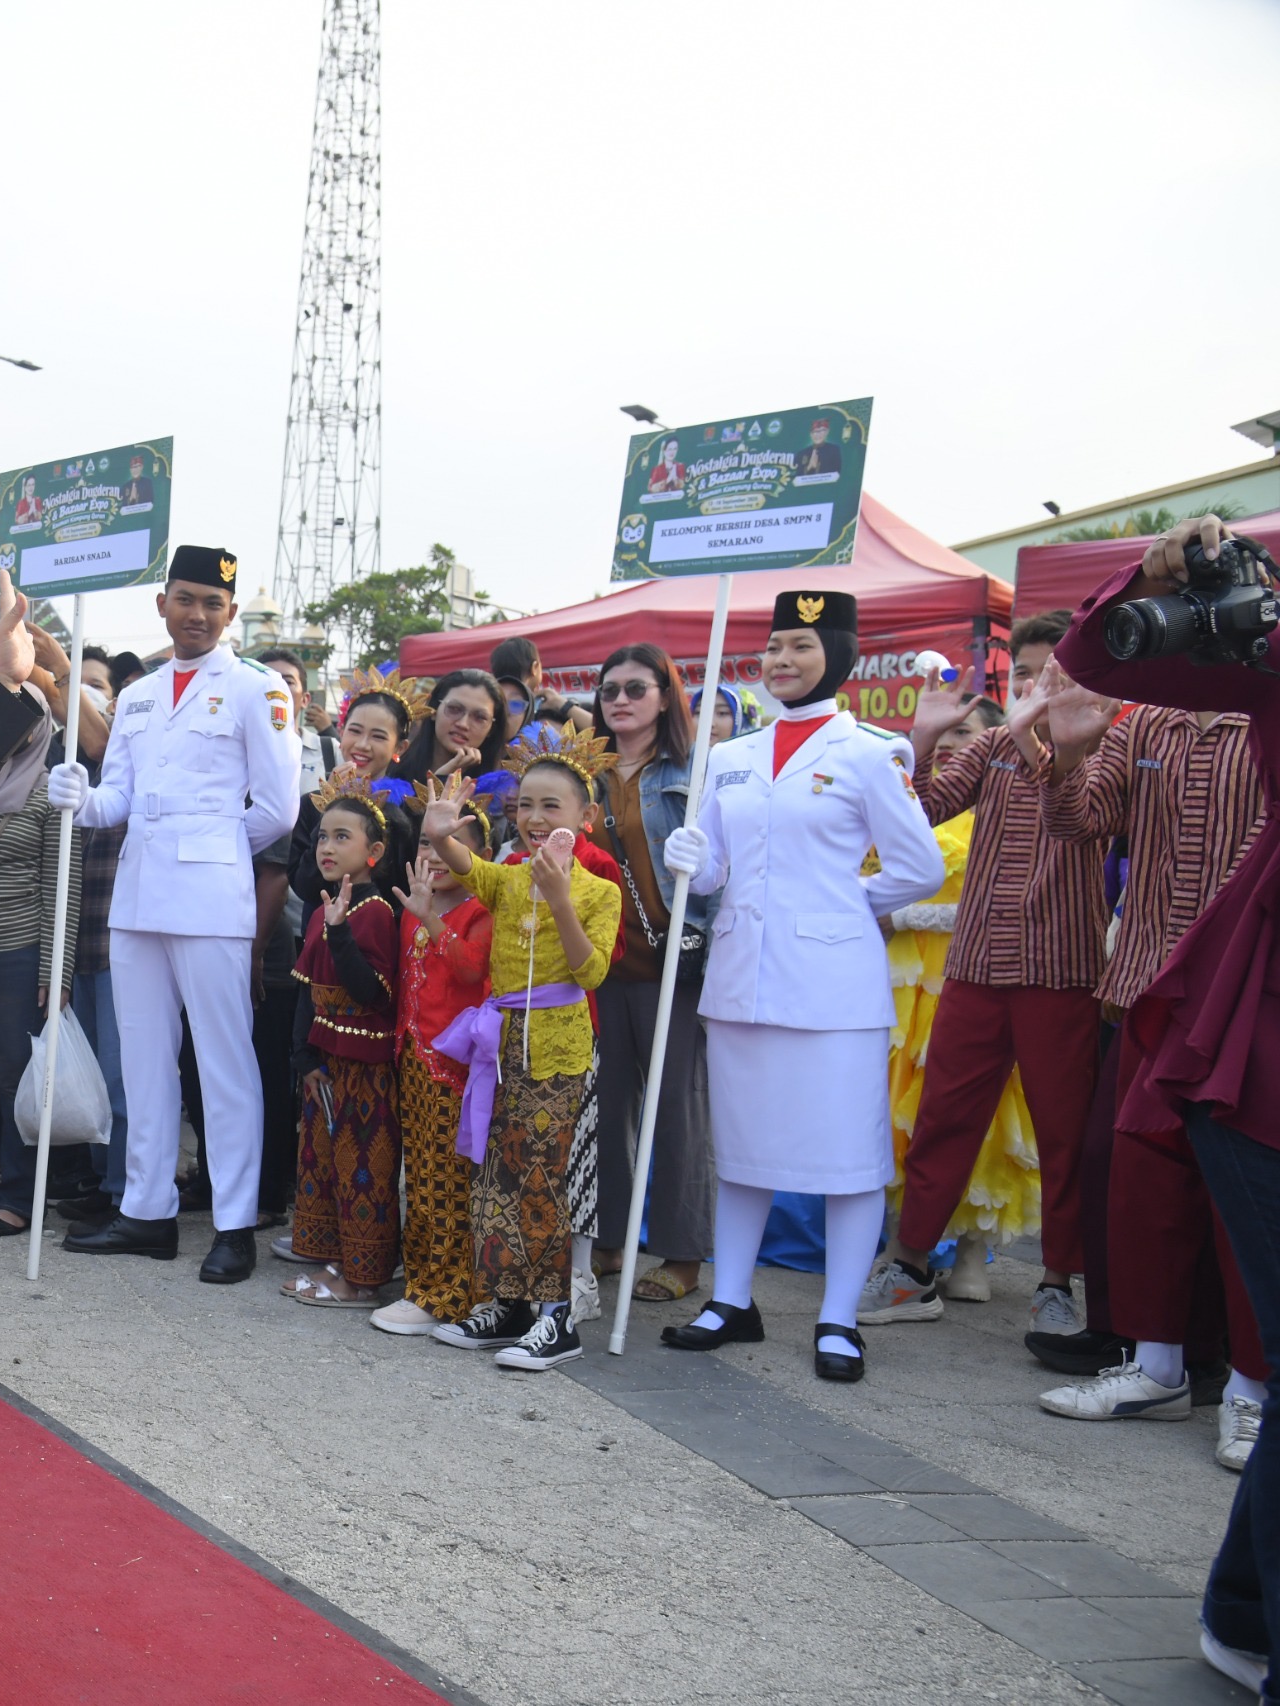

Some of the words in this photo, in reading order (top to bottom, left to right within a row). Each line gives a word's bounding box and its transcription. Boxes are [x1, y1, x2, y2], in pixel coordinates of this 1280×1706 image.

[708, 470, 749, 487] Bazaar
[751, 467, 778, 481] Expo
[89, 498, 109, 512] Expo
[660, 524, 713, 537] KELOMPOK
[715, 520, 752, 532] BERSIH
[754, 517, 781, 528] DESA
[783, 514, 813, 525] SMPN
[707, 535, 764, 549] SEMARANG
[54, 555, 86, 566] BARISAN
[847, 650, 923, 681] HARG
[541, 670, 601, 693] NEK
